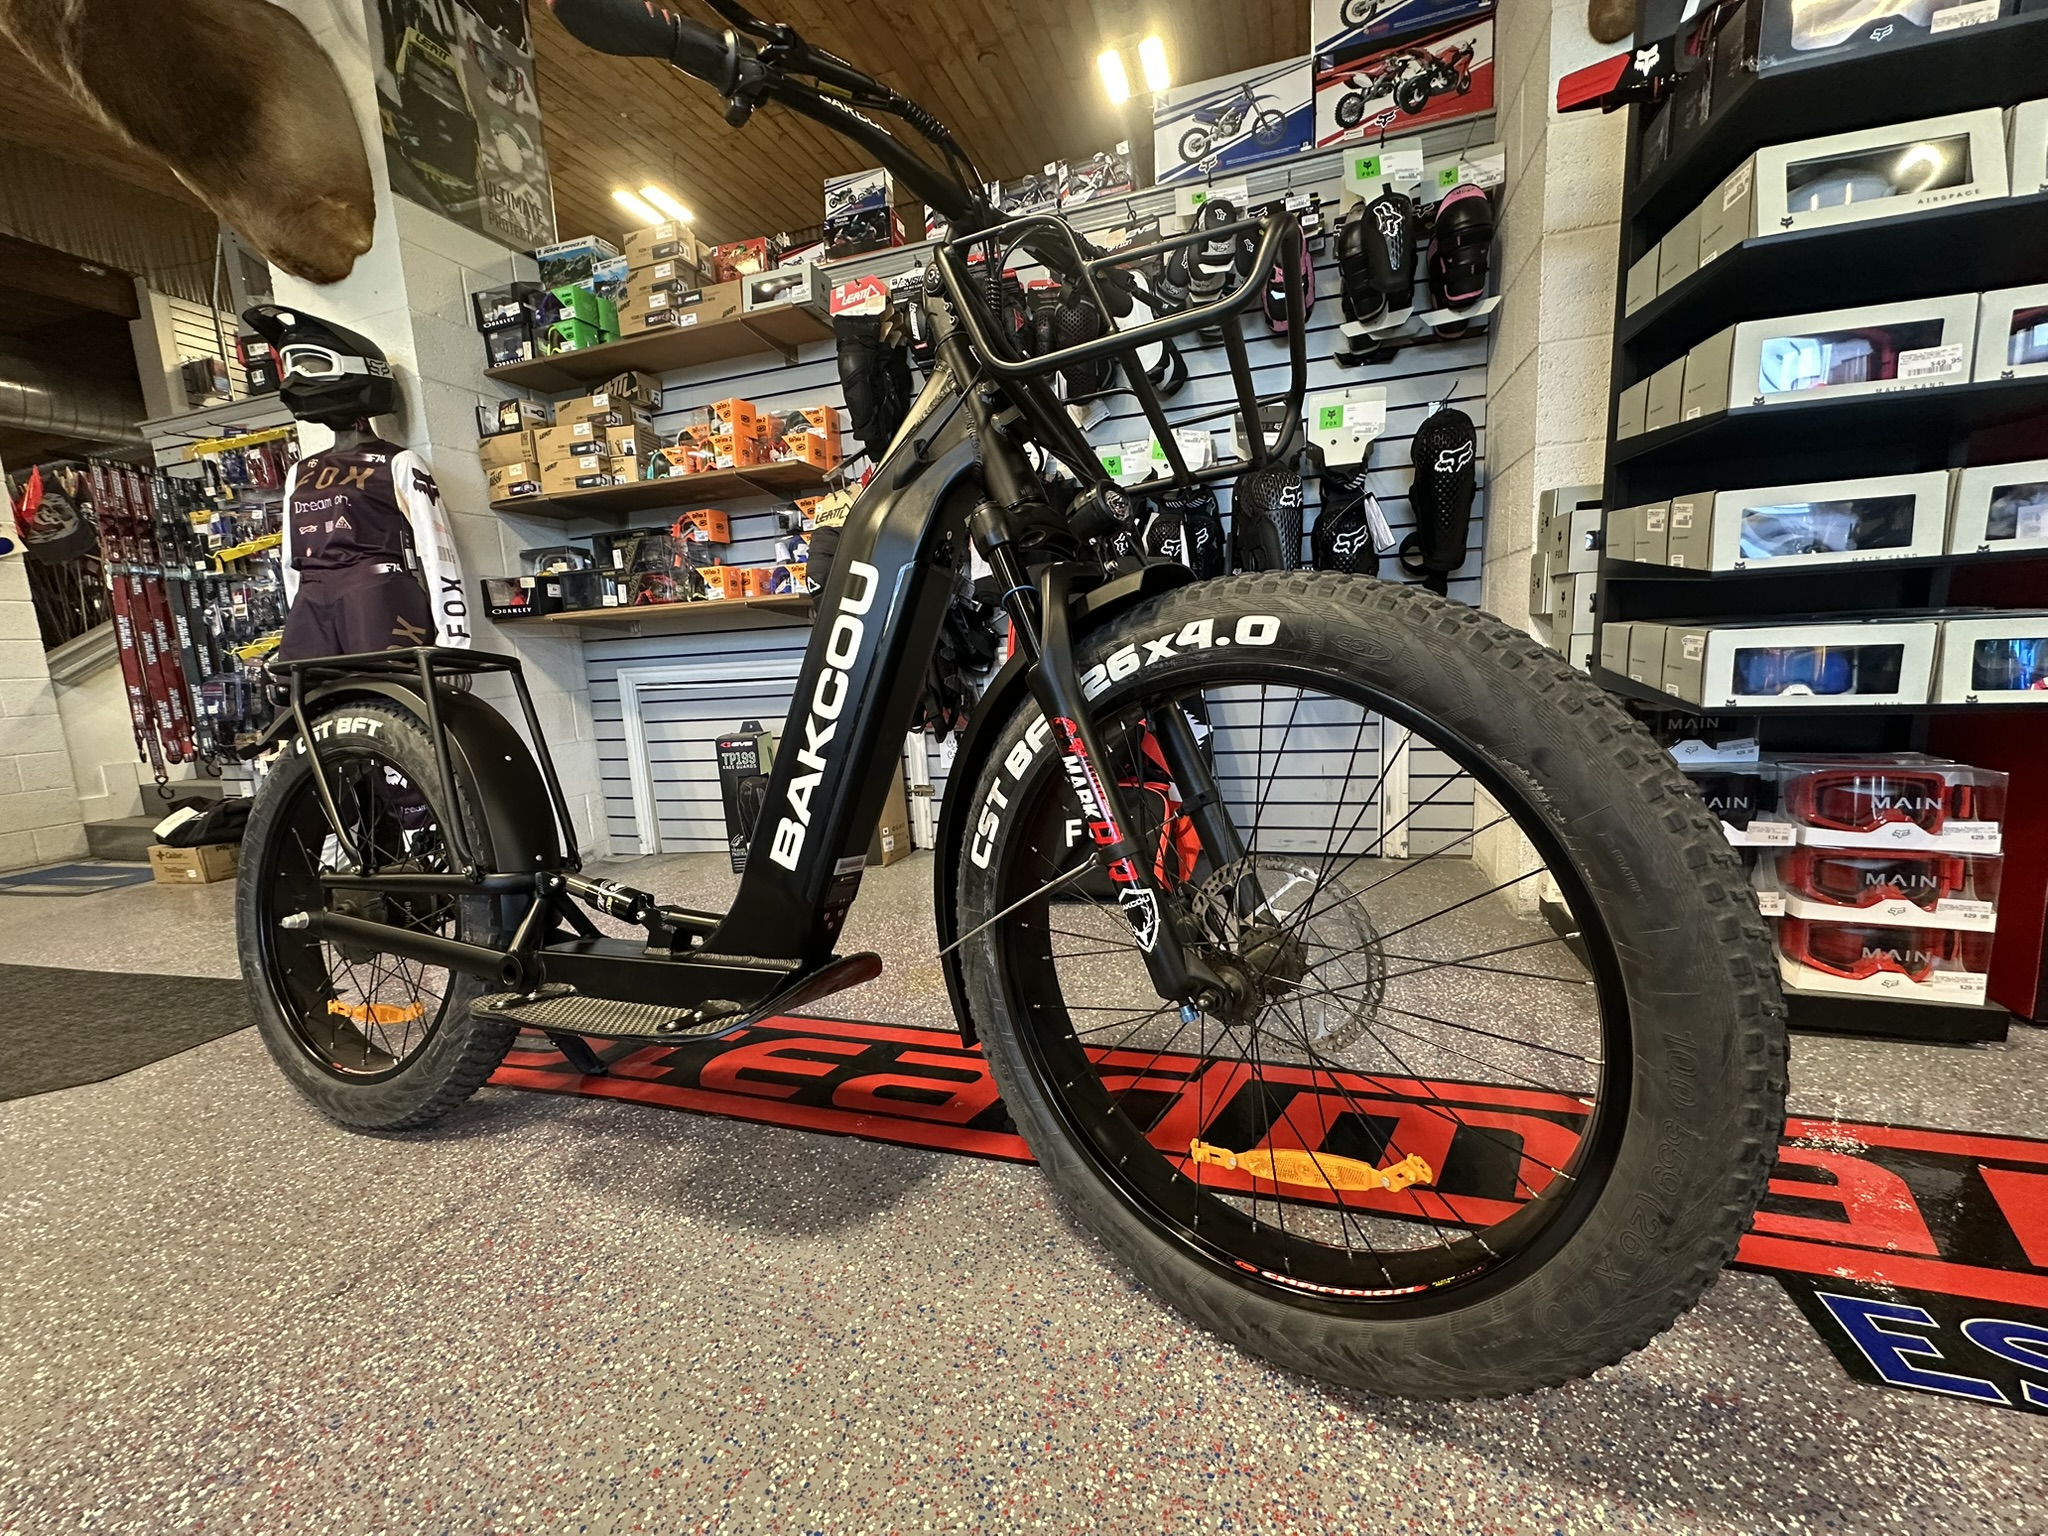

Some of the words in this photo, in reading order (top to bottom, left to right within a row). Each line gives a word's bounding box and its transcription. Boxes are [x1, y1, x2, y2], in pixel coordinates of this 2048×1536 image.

[483, 178, 545, 228] ULTIMATE
[1917, 188, 1982, 206] AIRSPACE
[1913, 382, 1945, 391] SAND
[294, 465, 375, 491] FOX
[294, 497, 332, 514] Dream
[1554, 550, 1563, 559] FOX
[440, 575, 471, 639] FOX
[502, 606, 532, 614] OAKLEY
[1558, 609, 1567, 619] FOX
[1079, 614, 1282, 703] 26x4.0
[769, 559, 880, 872] BAKCOU
[1667, 717, 1720, 730] MAIN
[336, 716, 384, 738] BFT
[721, 751, 757, 766] TP199
[970, 776, 1010, 870] CST
[1004, 711, 1053, 781] BF
[1062, 754, 1102, 819] MARK
[1702, 797, 1749, 809] AIN
[1870, 796, 1943, 811] MAIN
[1865, 872, 1938, 889] MAIN
[1862, 946, 1932, 963] MAIN
[1260, 1270, 1415, 1297] CHAMPION
